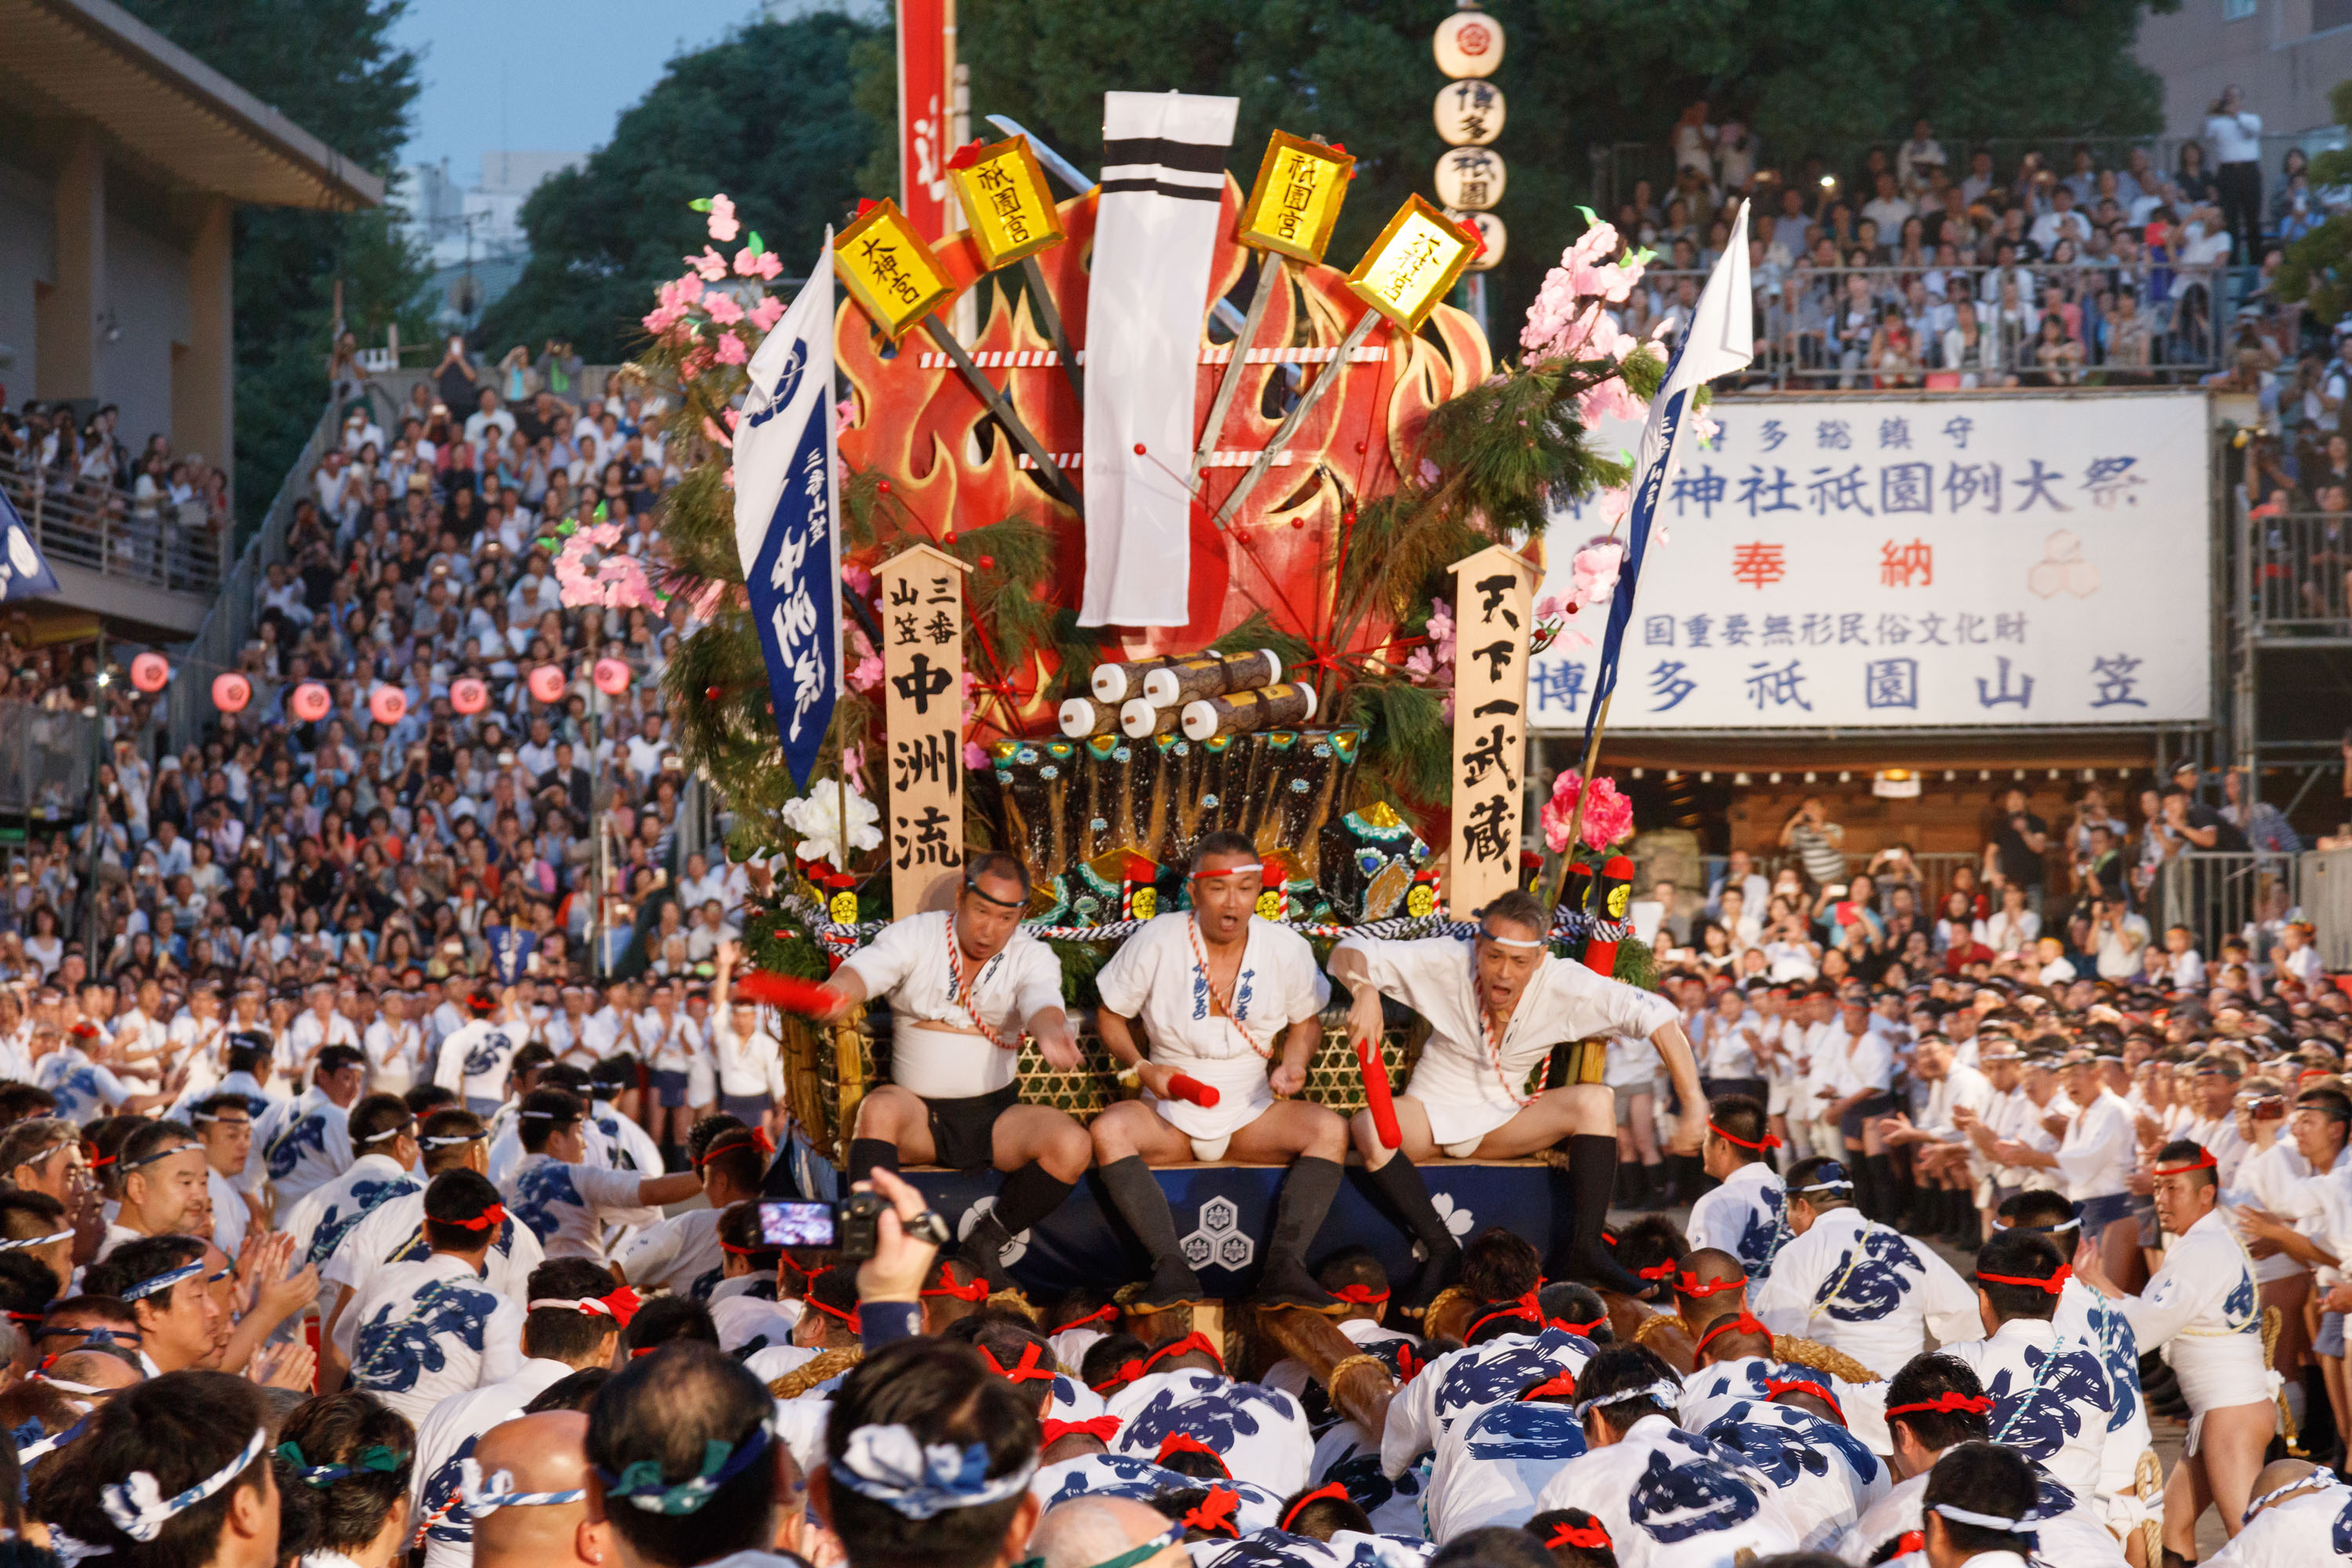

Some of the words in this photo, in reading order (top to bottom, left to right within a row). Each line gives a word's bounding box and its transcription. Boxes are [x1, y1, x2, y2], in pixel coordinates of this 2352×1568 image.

[977, 159, 1029, 244] 祇園宮
[1278, 154, 1316, 240] 祇園宮
[861, 238, 920, 304] 大神宮
[1552, 456, 2148, 519] 神社祇園例大祭
[1733, 539, 1933, 590] 奉納
[890, 577, 921, 645] 山笠
[924, 577, 958, 645] 三番
[1644, 612, 2030, 648] 国重要無形民俗文化財
[1530, 654, 2150, 713] 博多祇園山笠
[1462, 574, 1519, 875] 天下一武蔵
[891, 652, 962, 870] 中洲流
